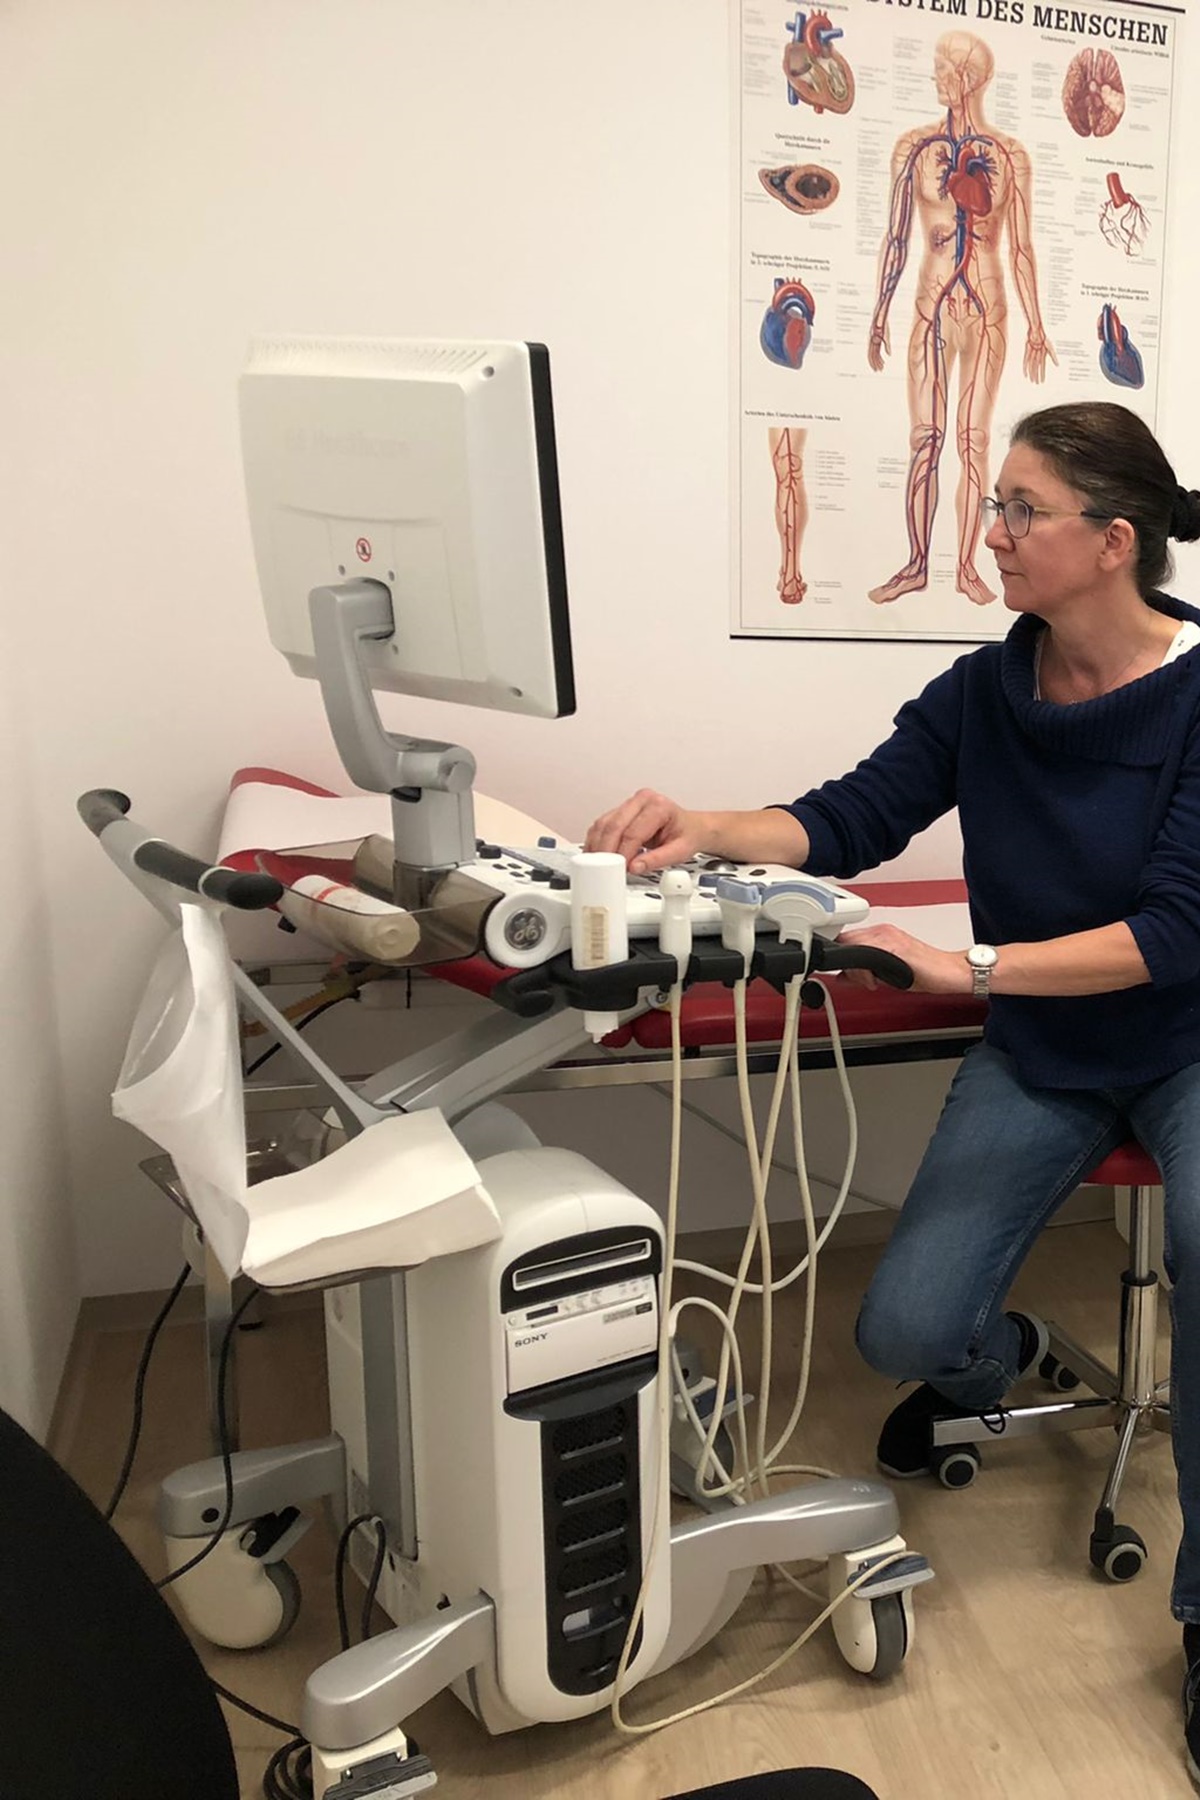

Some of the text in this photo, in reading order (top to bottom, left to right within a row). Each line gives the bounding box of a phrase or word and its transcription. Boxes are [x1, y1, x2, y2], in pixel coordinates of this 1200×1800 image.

[976, 0, 1024, 24] DES
[1033, 5, 1168, 45] MENSCHEN
[514, 1332, 548, 1347] SONY
